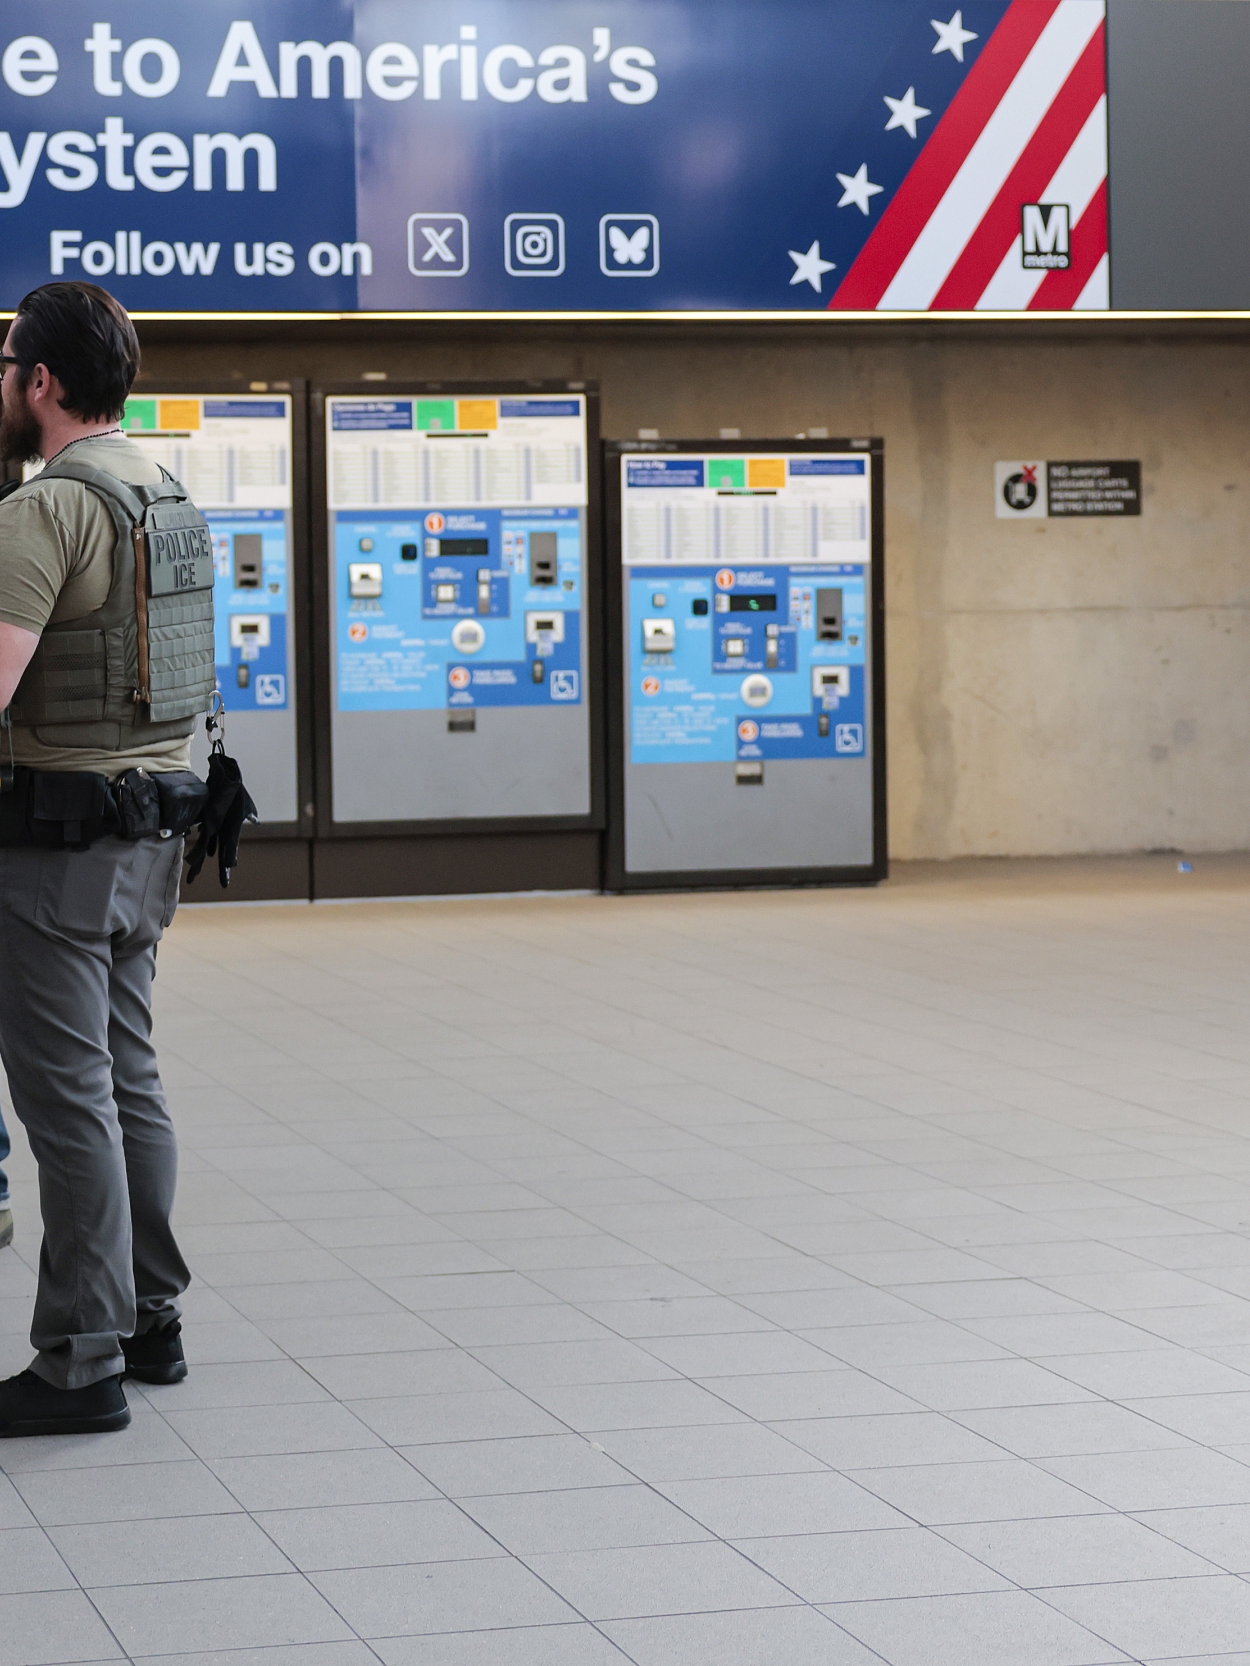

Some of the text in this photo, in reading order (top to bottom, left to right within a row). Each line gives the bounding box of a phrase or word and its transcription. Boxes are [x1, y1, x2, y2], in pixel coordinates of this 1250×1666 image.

[85, 22, 181, 98] to
[206, 20, 659, 105] America’s
[1023, 204, 1069, 253] M
[50, 229, 221, 278] Follow
[235, 241, 295, 278] us
[308, 241, 374, 277] on
[1024, 252, 1069, 269] metro
[153, 529, 209, 566] POLICE
[173, 562, 197, 589] ICE
